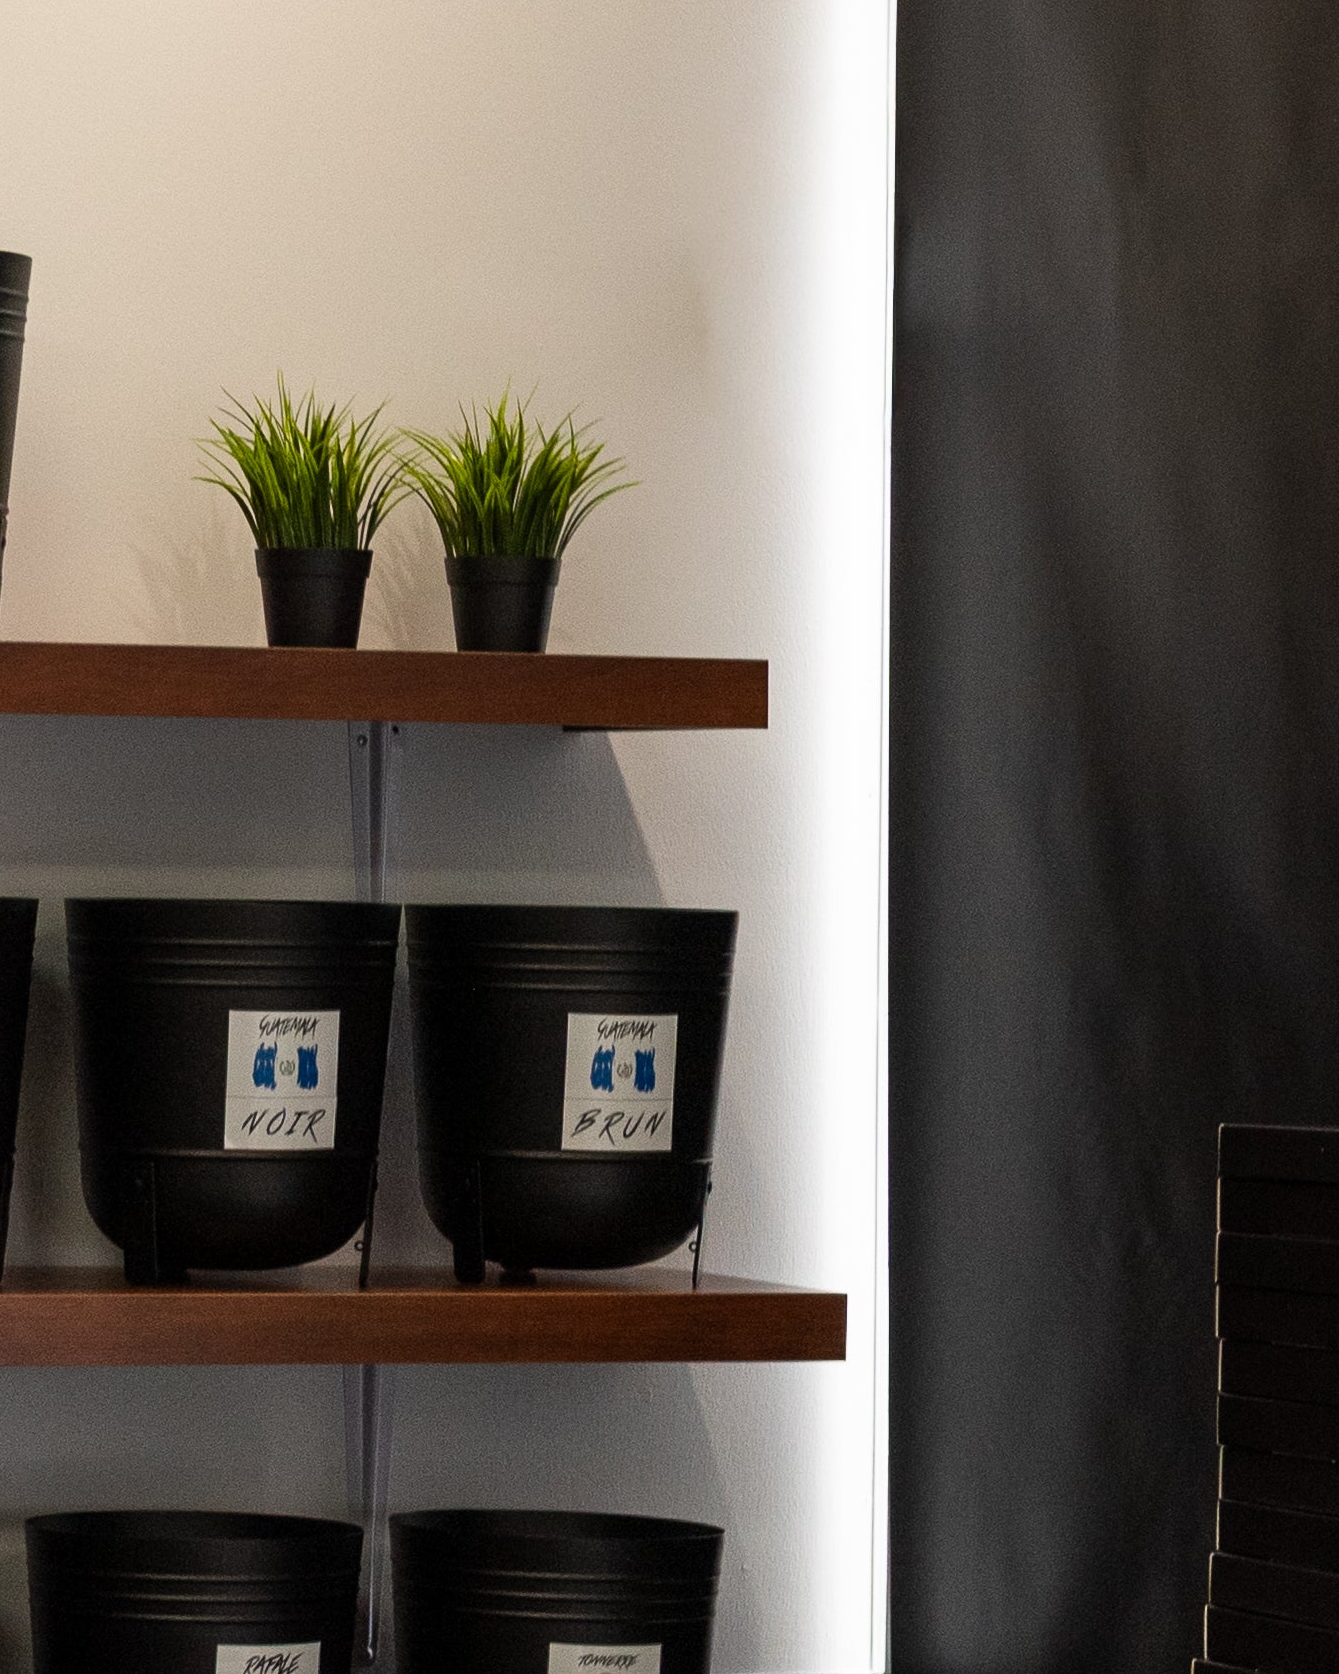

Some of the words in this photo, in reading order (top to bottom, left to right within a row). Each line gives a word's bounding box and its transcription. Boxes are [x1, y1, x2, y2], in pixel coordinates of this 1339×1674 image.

[258, 1014, 320, 1040] GUATEMALA
[597, 1018, 658, 1044] GUATEMALA
[241, 1107, 327, 1143] NOIR
[570, 1109, 667, 1146] BRUN
[577, 1653, 641, 1670] TONNERRE
